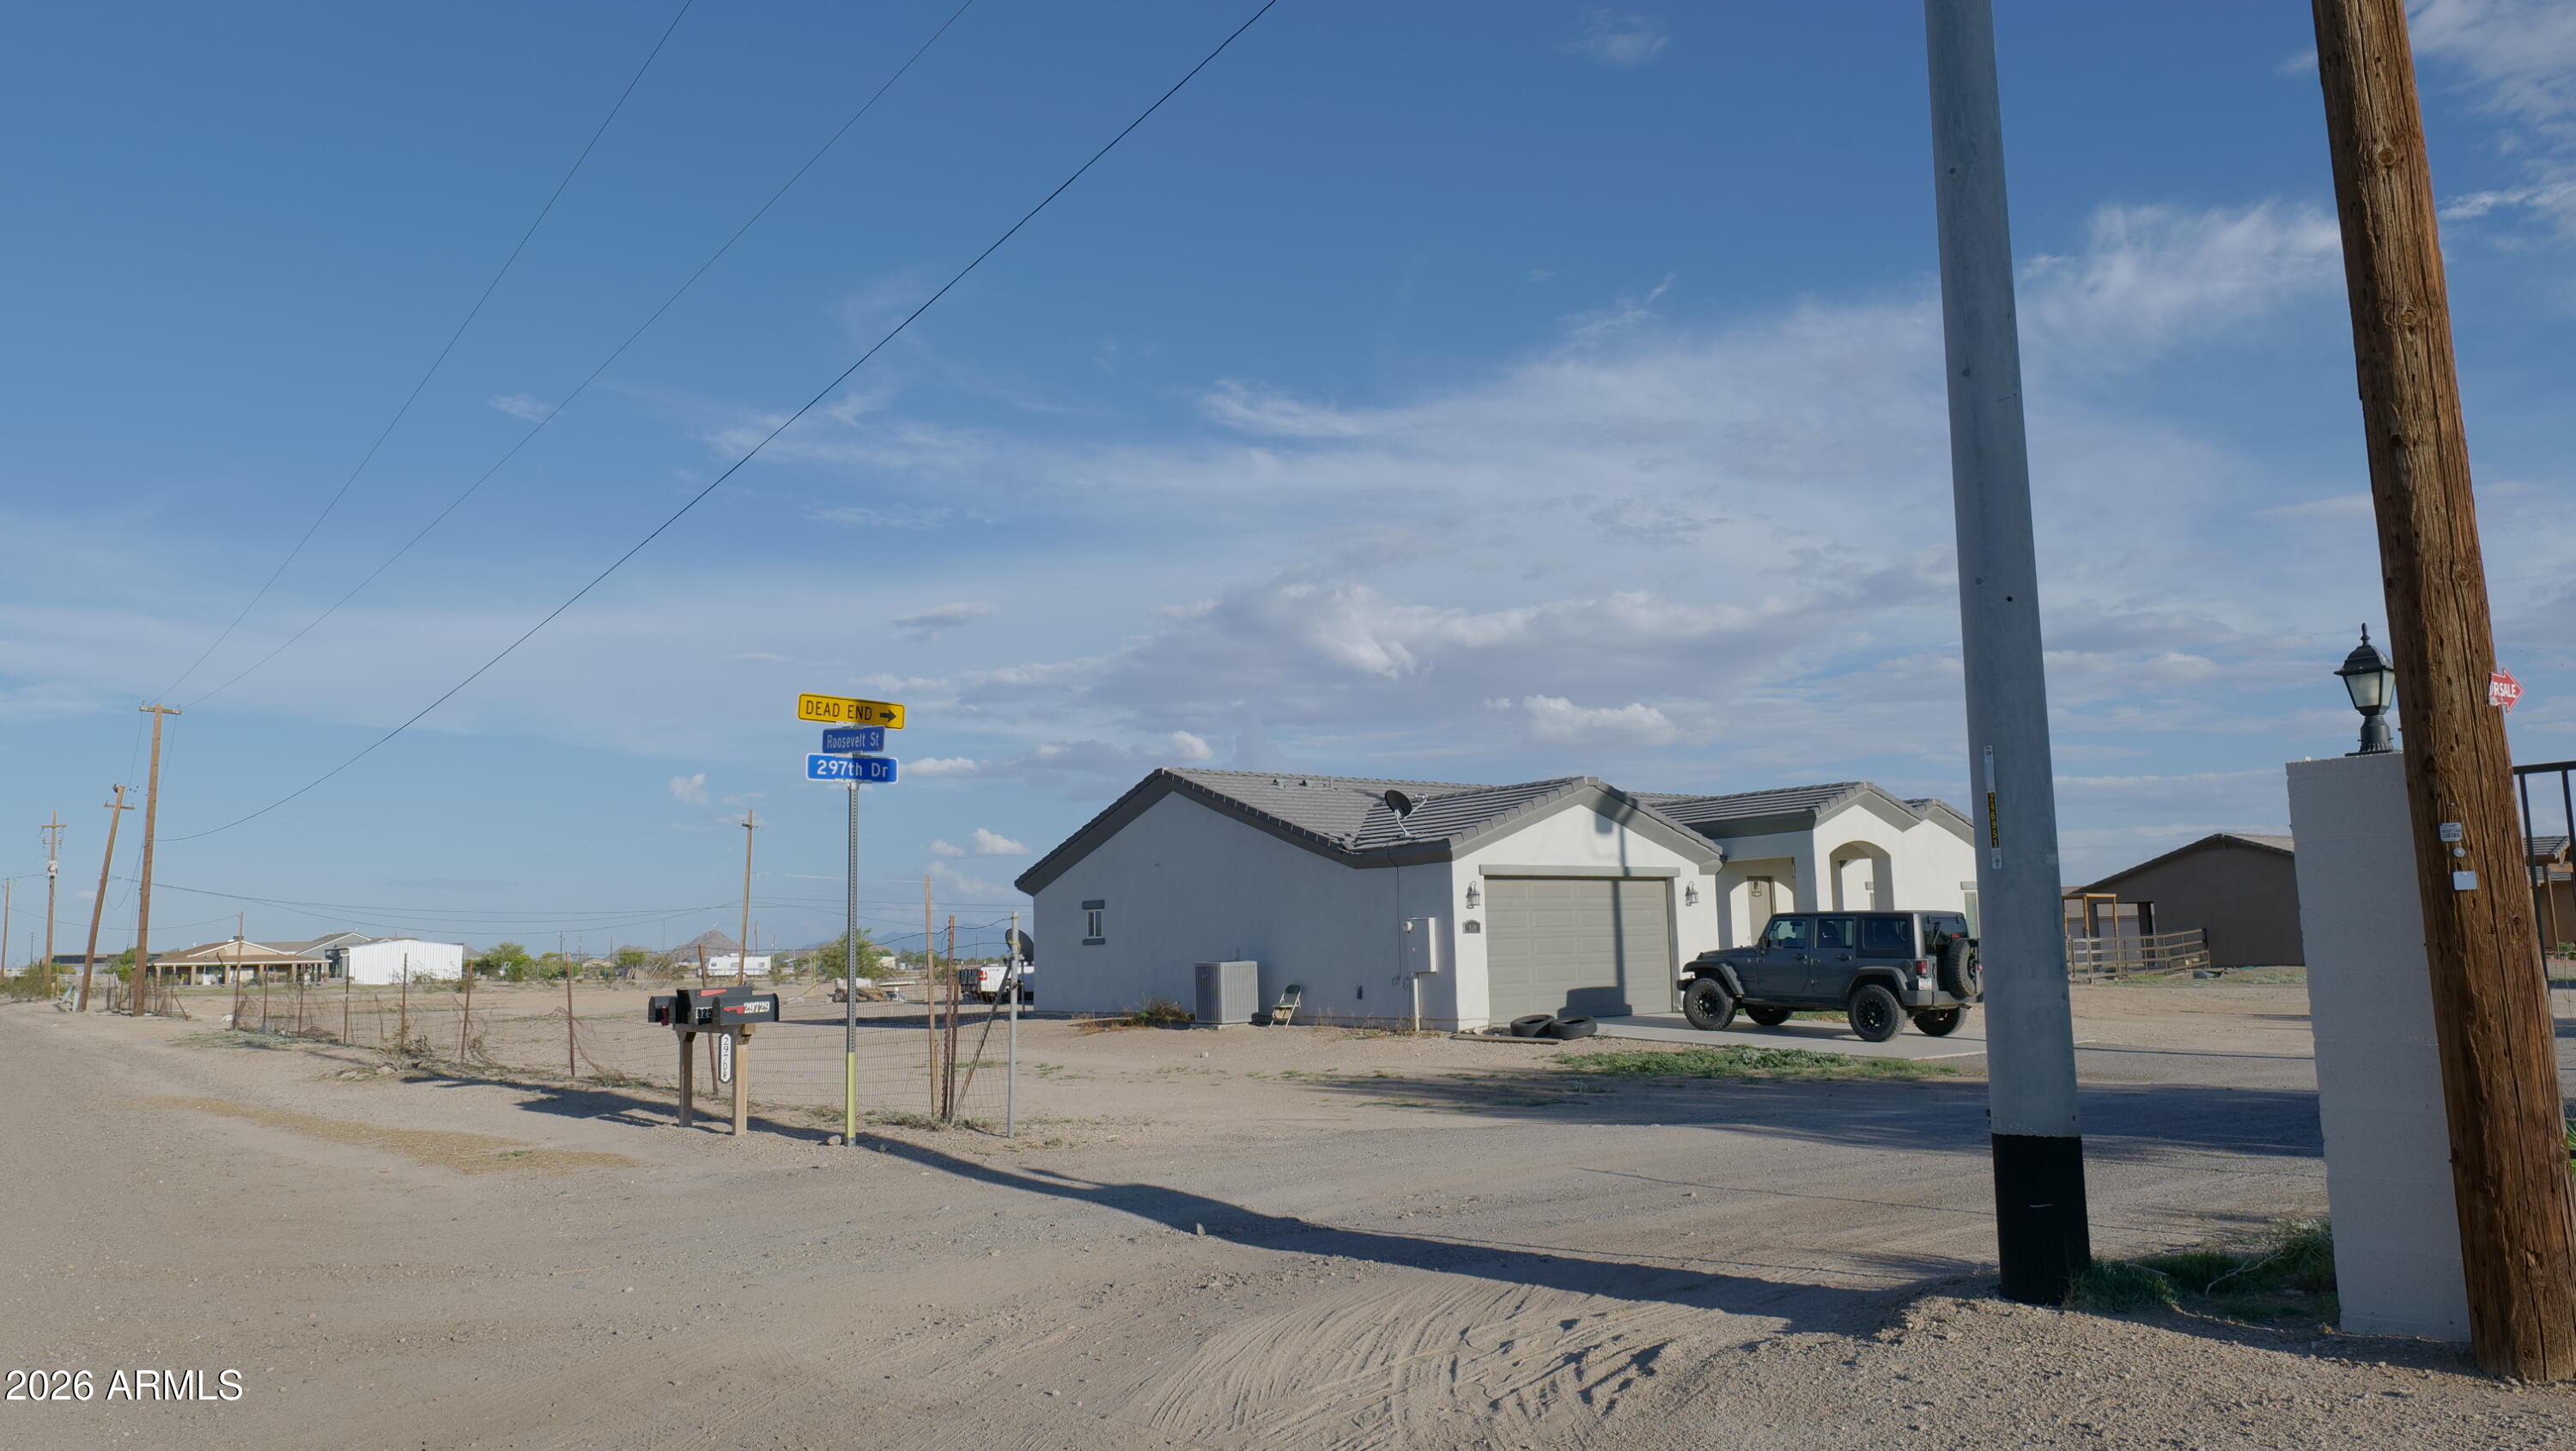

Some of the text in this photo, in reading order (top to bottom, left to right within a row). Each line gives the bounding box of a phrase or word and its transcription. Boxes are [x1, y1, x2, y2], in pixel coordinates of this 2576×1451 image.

[805, 700, 872, 721] DEAD END
[826, 732, 880, 750] Roosevelt St
[817, 760, 889, 778] 297th Dr
[744, 1001, 770, 1014] 29729
